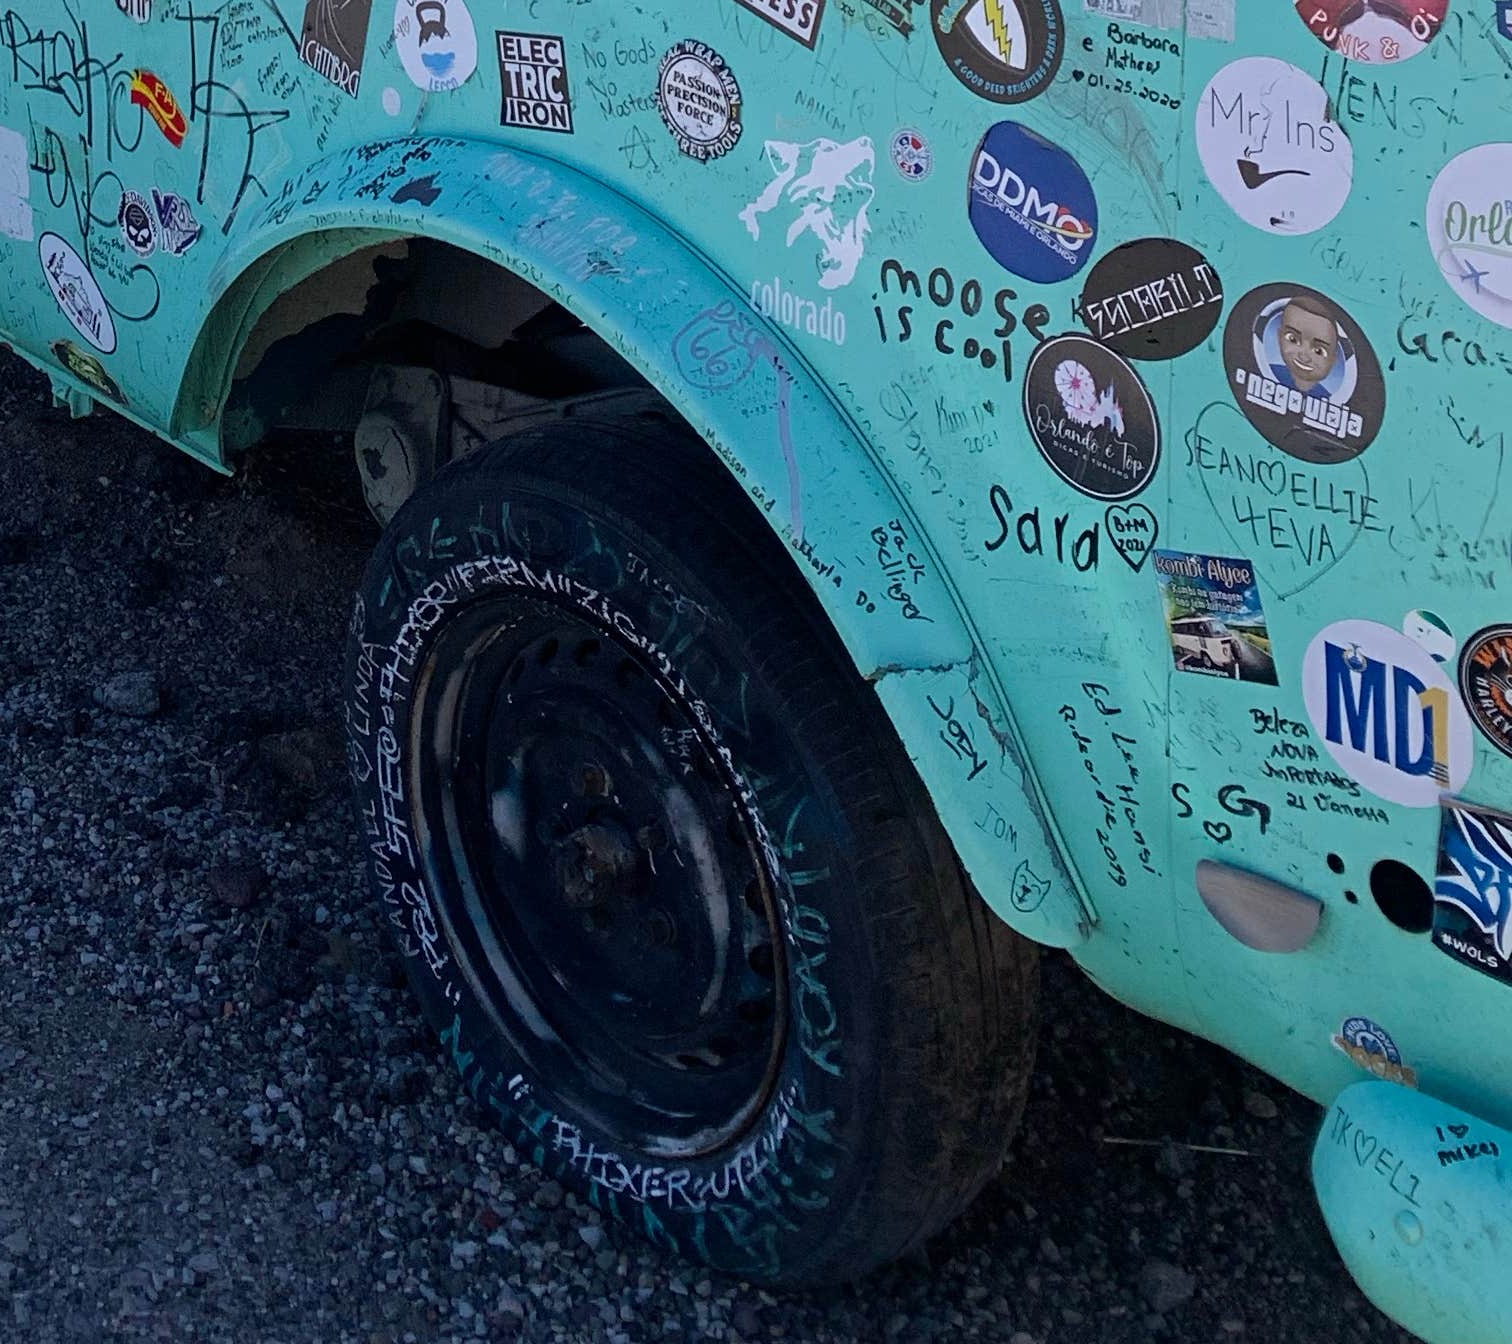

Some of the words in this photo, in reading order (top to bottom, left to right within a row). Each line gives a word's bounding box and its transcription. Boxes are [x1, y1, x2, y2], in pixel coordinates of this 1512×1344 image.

[501, 38, 559, 64] ELEC
[614, 37, 656, 65] Gods
[1107, 23, 1181, 57] Barbara
[1309, 8, 1369, 60] PUNK
[1380, 36, 1400, 61] &
[504, 63, 565, 103] TRIC
[666, 82, 727, 114] PRECISION
[673, 70, 721, 100] PASSION
[505, 98, 569, 130] IRON
[973, 150, 1092, 251] DDMO
[1035, 229, 1077, 265] ORLANDO
[750, 276, 846, 347] colorado
[881, 258, 1051, 343] moose
[872, 292, 913, 344] is
[934, 319, 1013, 383] cool
[1116, 441, 1145, 478] Top
[1185, 426, 1256, 484] SEAN
[1291, 471, 1387, 534] ELLIE
[984, 484, 1100, 573] Sara
[1475, 675, 1512, 733] HARLEY
[1441, 932, 1499, 970] #WOLS
